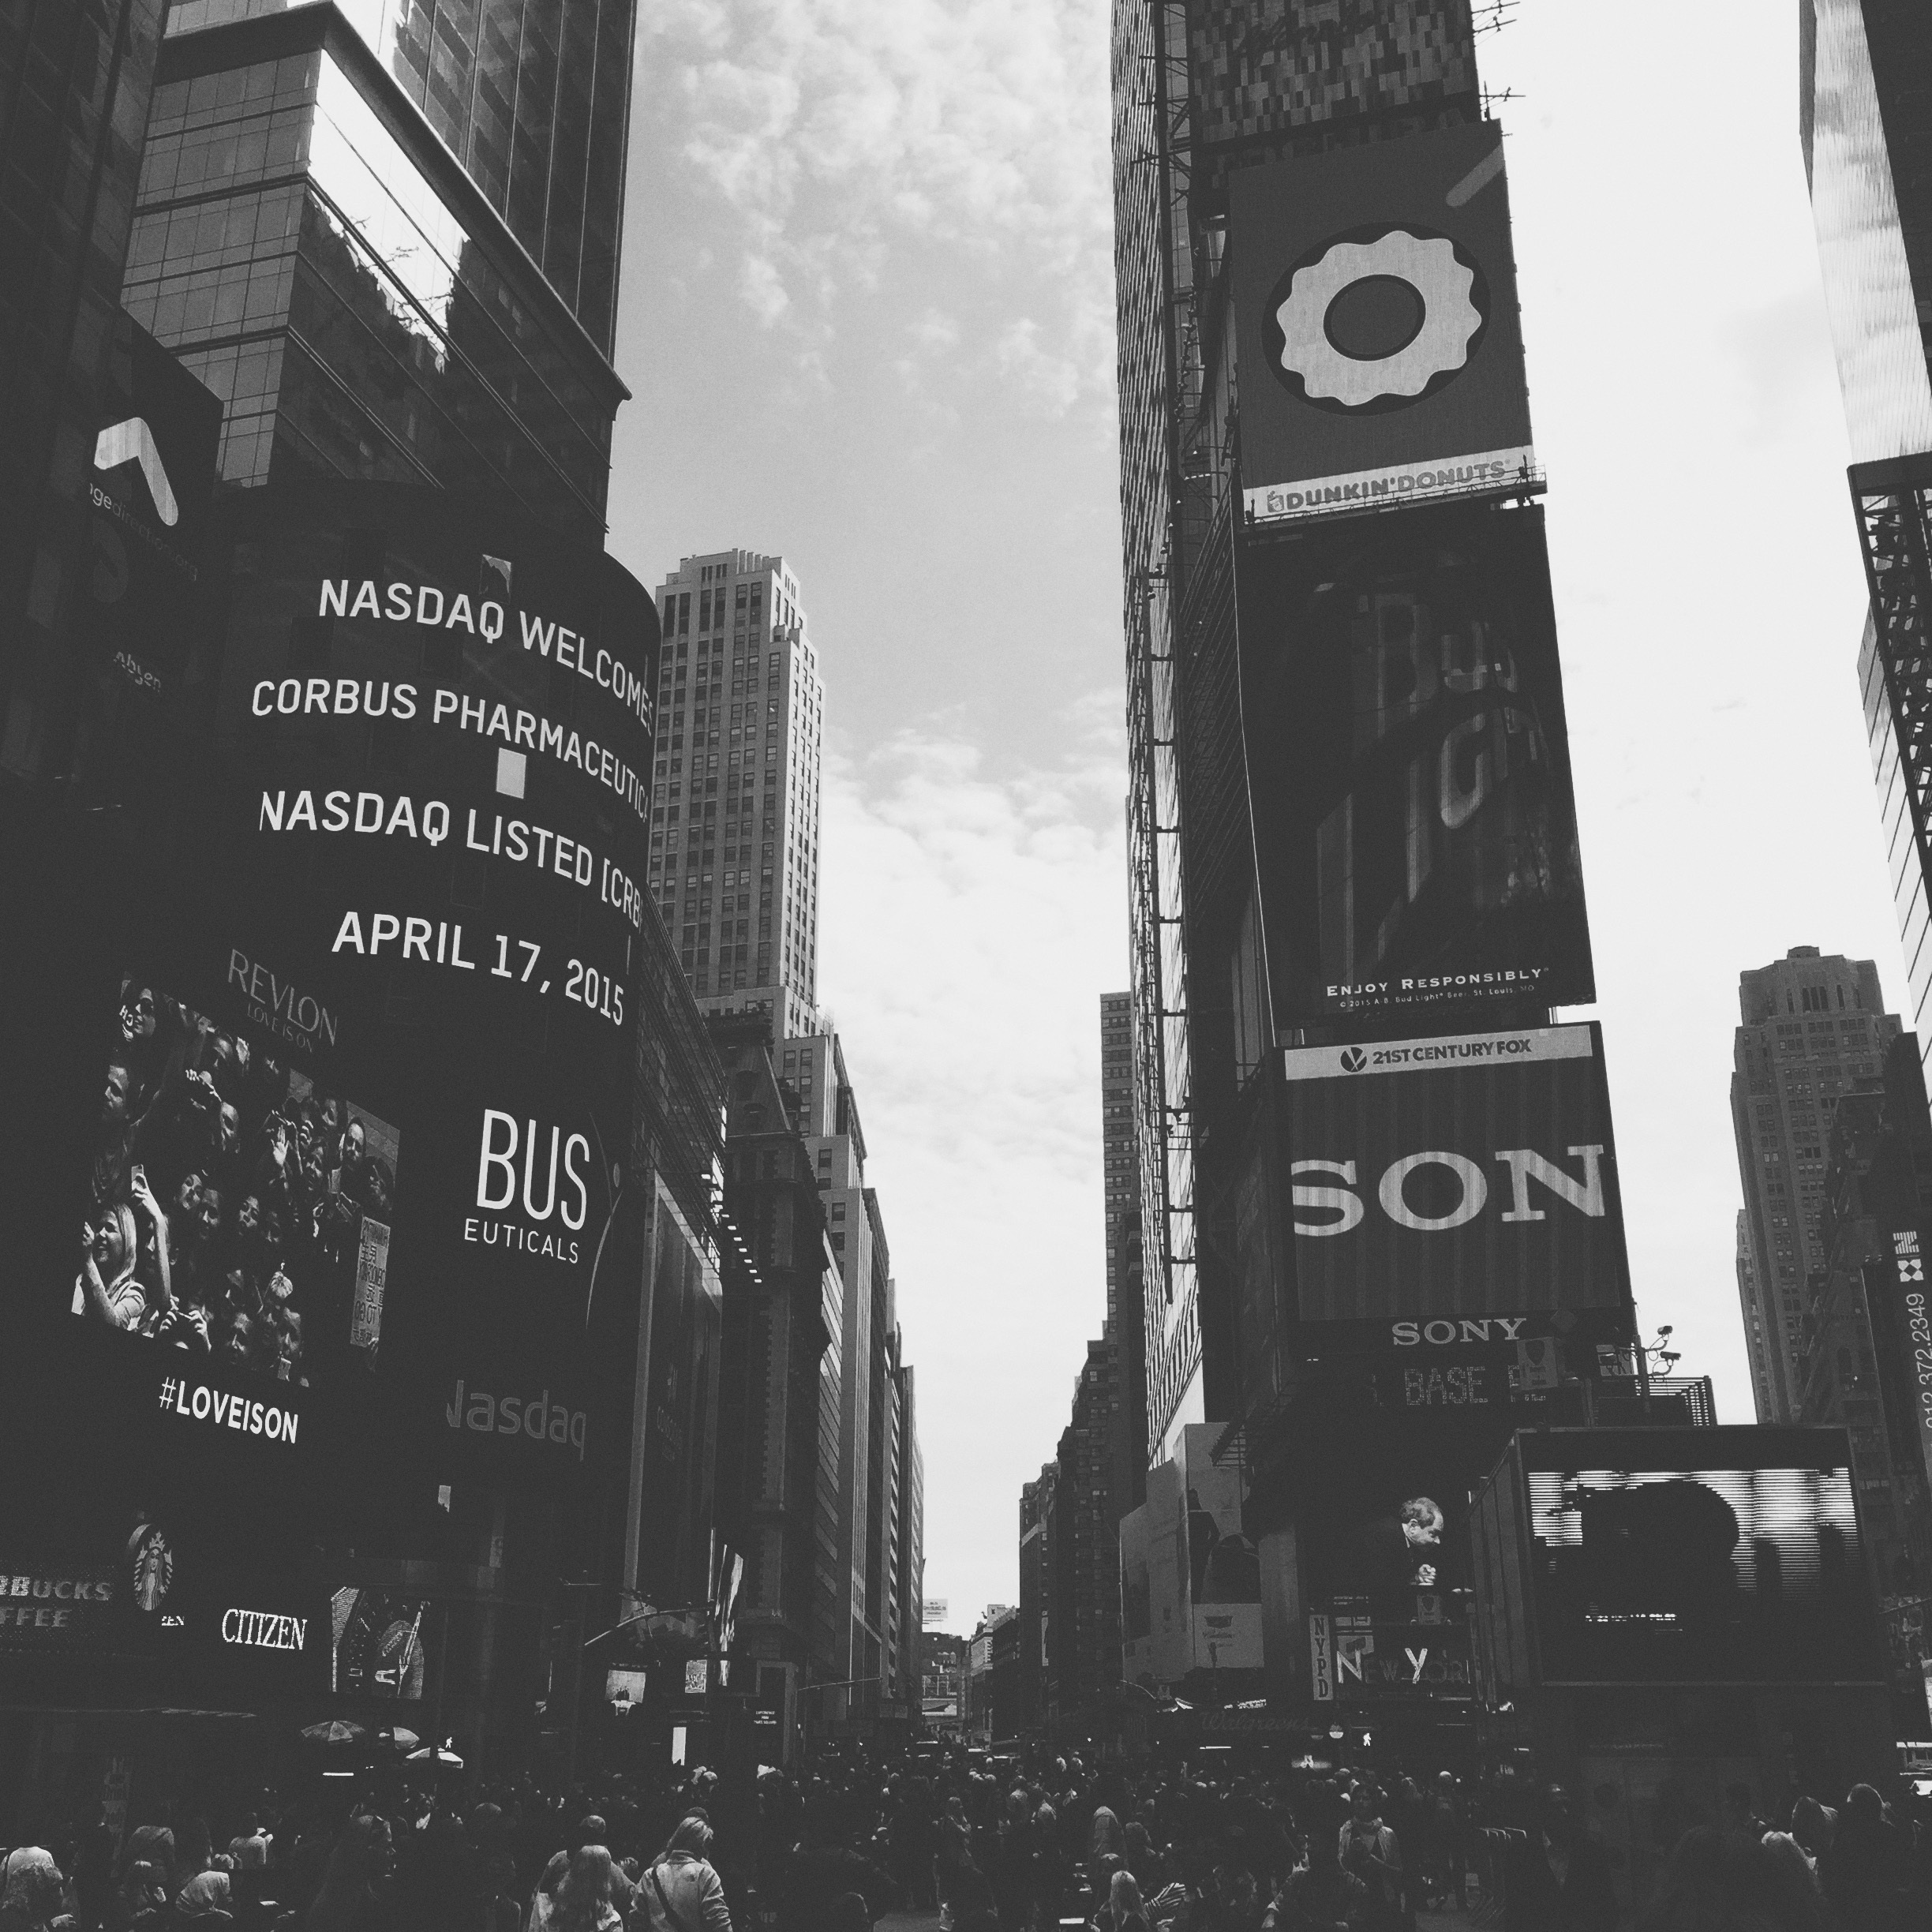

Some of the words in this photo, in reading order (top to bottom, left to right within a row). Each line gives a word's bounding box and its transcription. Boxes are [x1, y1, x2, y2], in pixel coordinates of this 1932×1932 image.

[1398, 461, 1505, 492] DONUTS
[319, 579, 504, 643] NASDAQ
[520, 611, 653, 737] WELCOMES
[253, 679, 417, 719] CORBUS
[260, 791, 449, 846] NASDAQ
[466, 809, 592, 886] LISTED
[601, 858, 642, 934] [CRB
[331, 912, 475, 969] APRIL
[491, 934, 550, 993] 17,
[565, 959, 623, 1025] 2015
[1327, 983, 1388, 997] ENJOY
[228, 949, 338, 1046] REVLON
[1349, 998, 1371, 1007] 2015
[1395, 995, 1412, 1004] Bud
[247, 1003, 278, 1032] LOVE
[283, 1024, 294, 1041] IS
[296, 1032, 313, 1053] ON
[1373, 1048, 1411, 1065] 21ST
[1412, 1041, 1494, 1061] CENTURY
[1496, 1039, 1532, 1055] FOX
[475, 1109, 590, 1230] BUS
[1291, 1145, 1604, 1236] SON
[464, 1219, 579, 1264] EUTICALS
[1392, 1318, 1526, 1345] SONY
[1404, 1366, 1488, 1405] BASE
[159, 1375, 298, 1443] #LOVEISON
[222, 1608, 307, 1649] CITIZEN
[1315, 1618, 1328, 1698] NYPD
[1336, 1649, 1399, 1684] NEW
[1404, 1648, 1471, 1684] YOR
[1200, 1711, 1310, 1737] Walgreens
